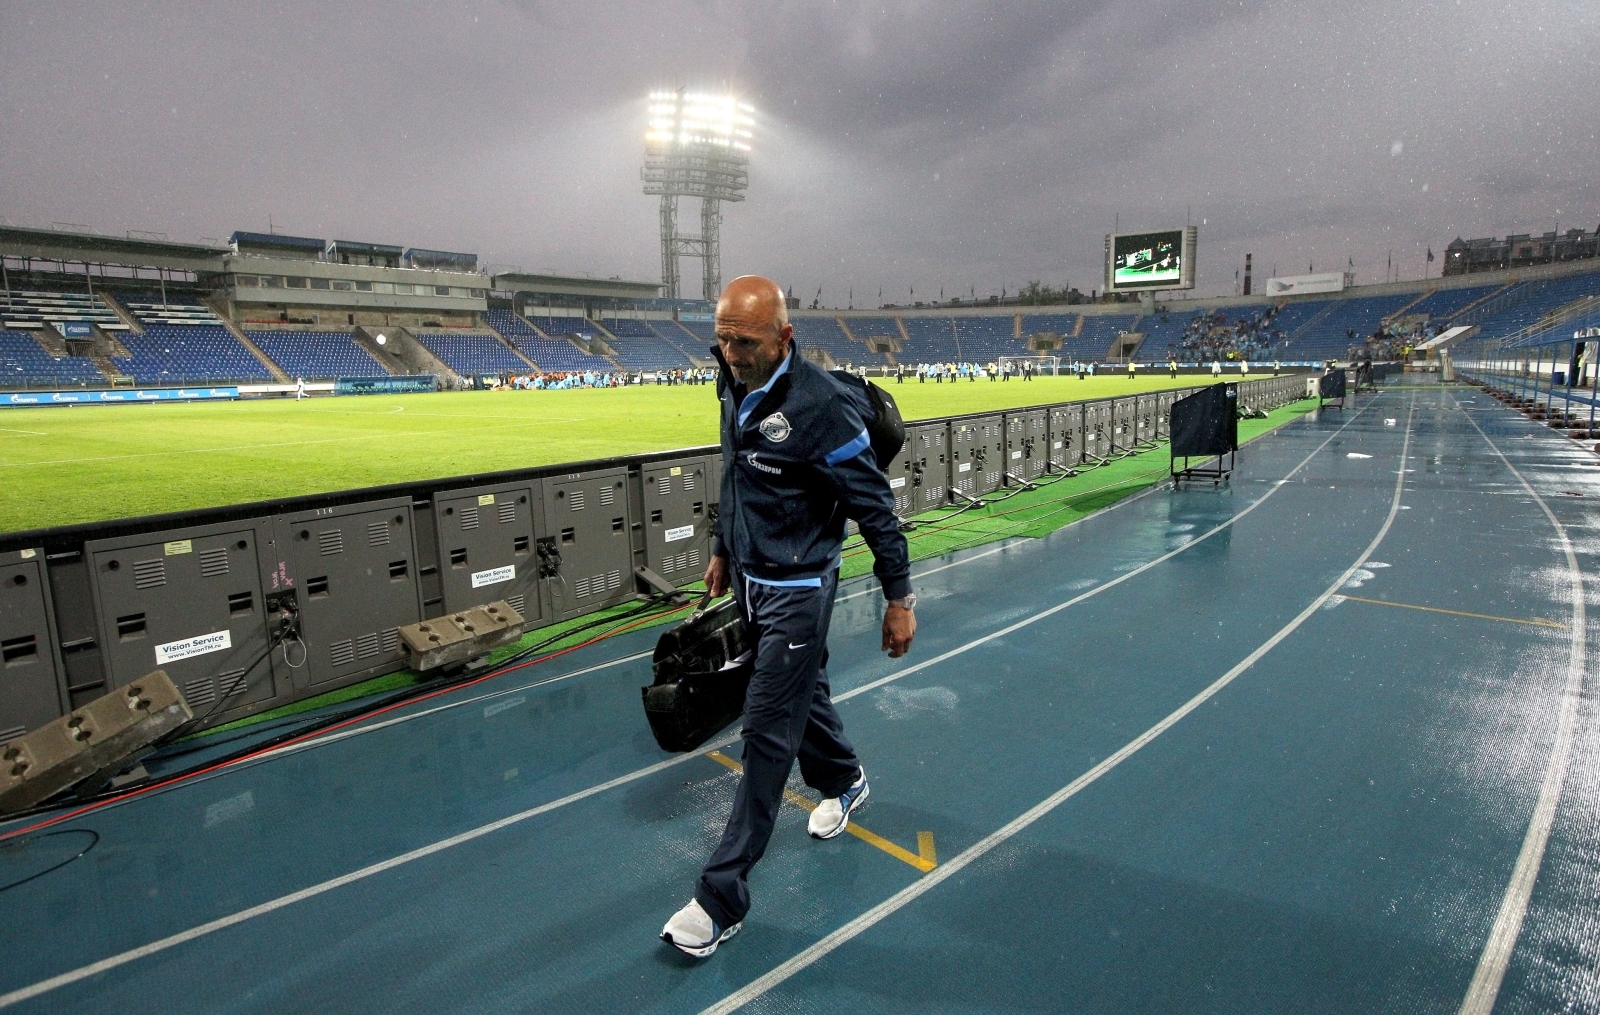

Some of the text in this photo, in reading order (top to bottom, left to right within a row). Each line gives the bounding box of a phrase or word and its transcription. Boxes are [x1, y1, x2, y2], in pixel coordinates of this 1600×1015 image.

[316, 507, 333, 516] 116
[475, 568, 512, 580] Vision Service
[162, 634, 224, 654] Vision Service
[168, 643, 222, 660] www.VisionTM.ru
